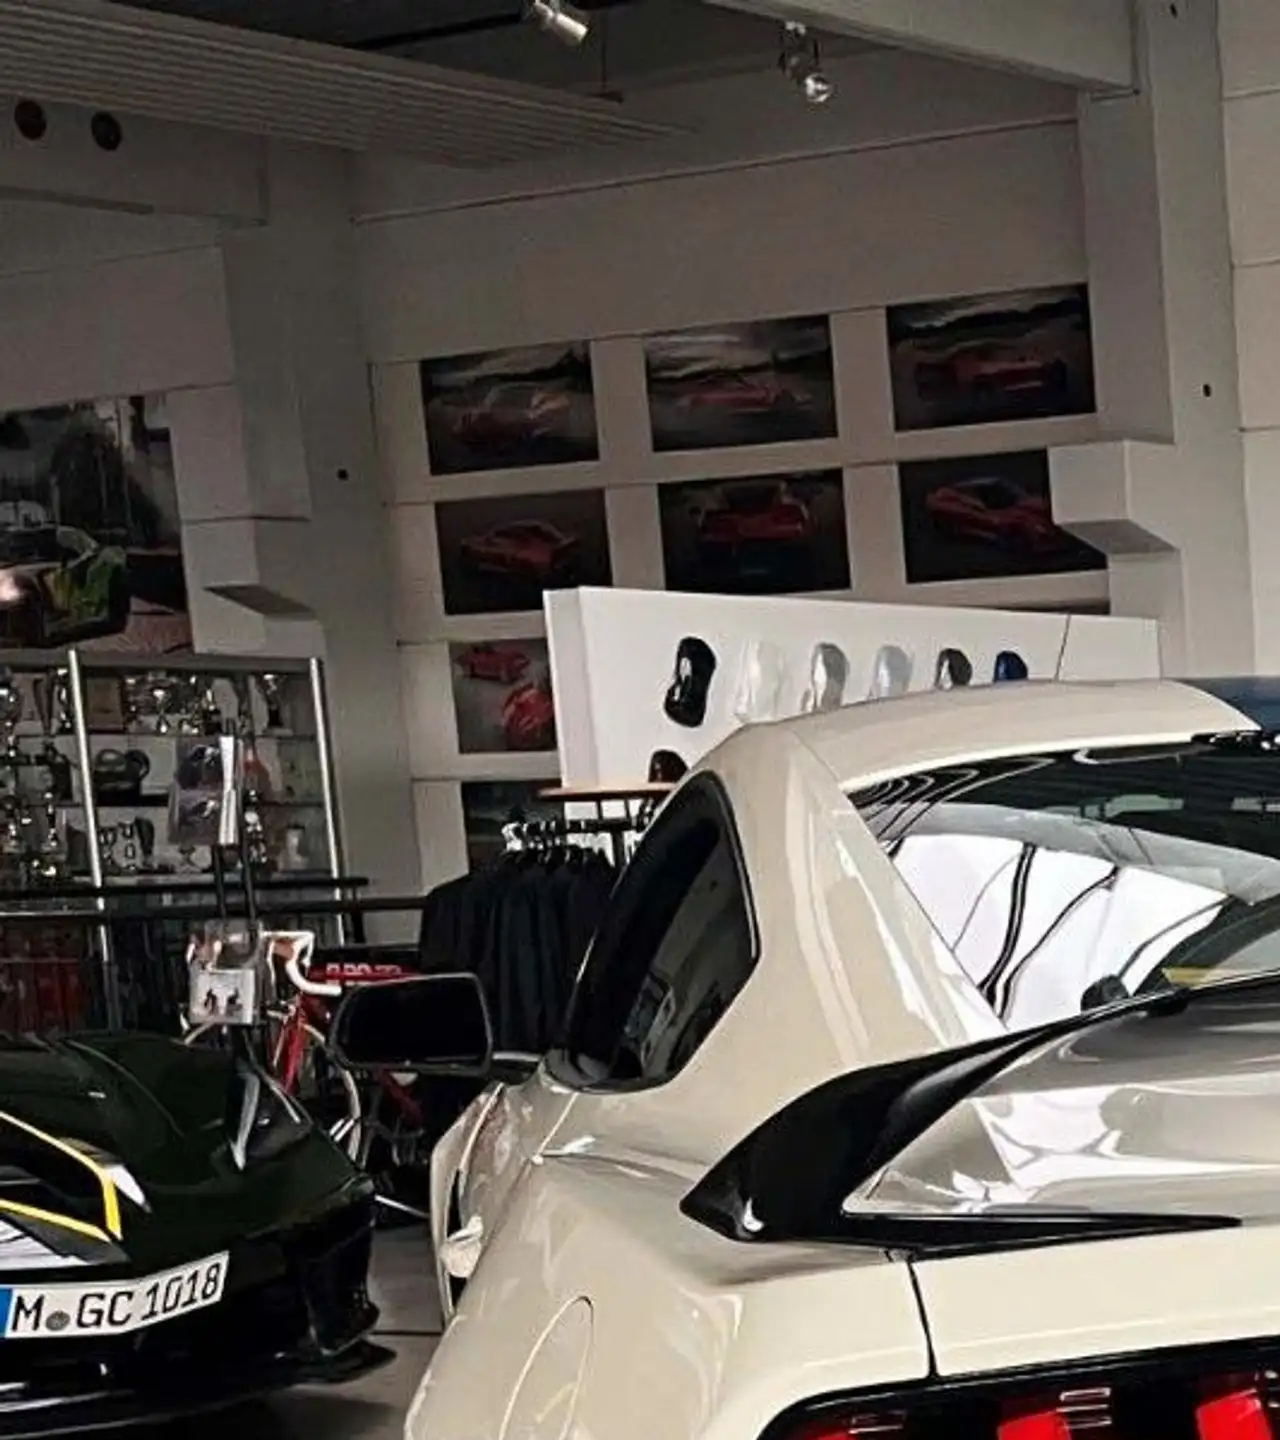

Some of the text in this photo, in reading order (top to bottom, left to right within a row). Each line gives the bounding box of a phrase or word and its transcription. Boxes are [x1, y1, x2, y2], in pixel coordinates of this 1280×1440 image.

[11, 1263, 221, 1332] M GC 1018
